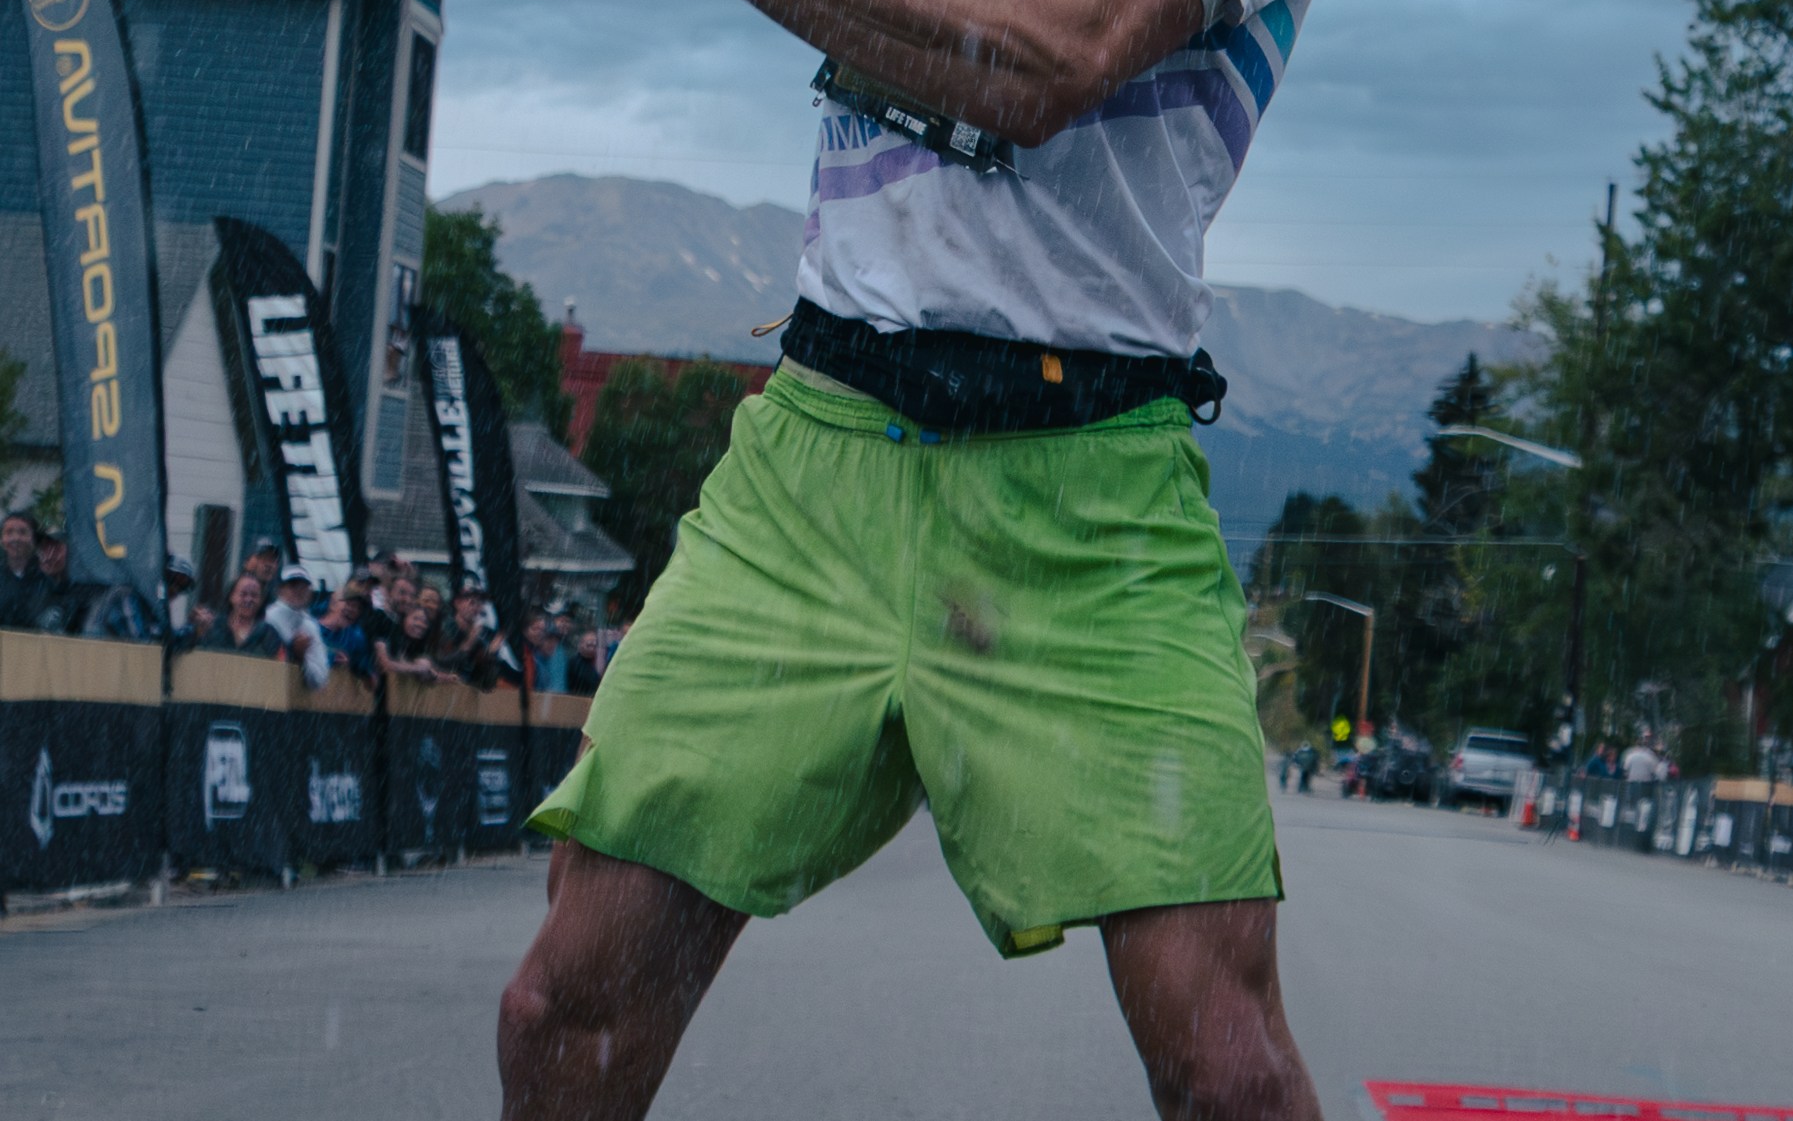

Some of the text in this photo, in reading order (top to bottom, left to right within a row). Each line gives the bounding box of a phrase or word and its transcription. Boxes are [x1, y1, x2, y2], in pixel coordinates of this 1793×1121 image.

[885, 106, 906, 125] LIFE
[904, 115, 928, 136] TIME
[247, 294, 354, 593] LIFE TIME
